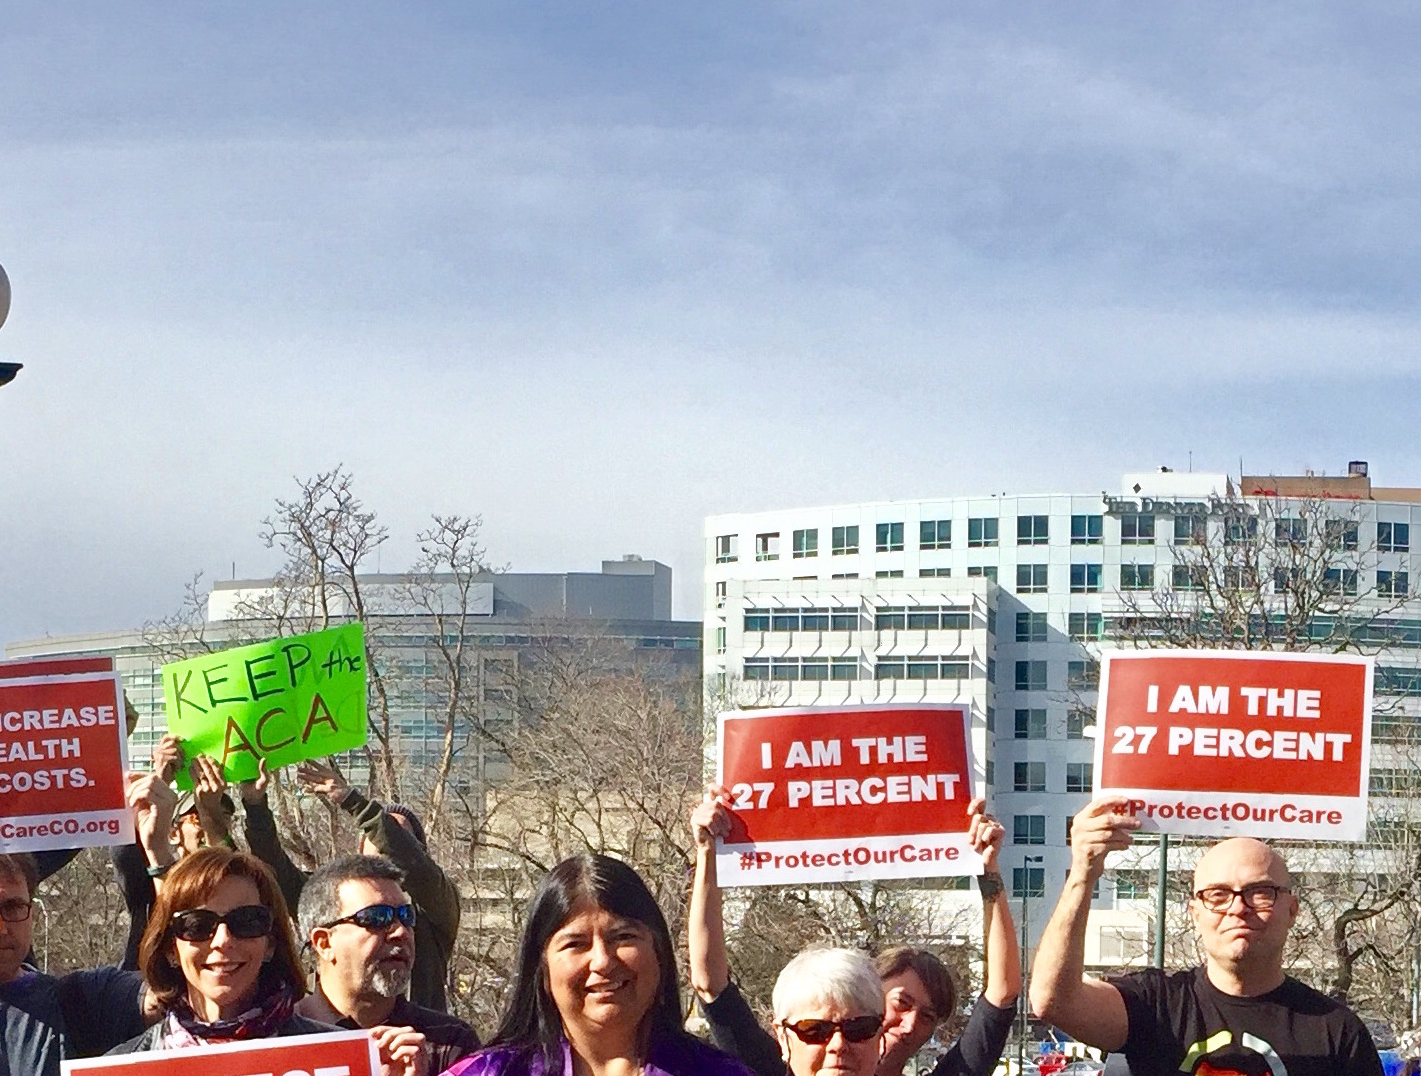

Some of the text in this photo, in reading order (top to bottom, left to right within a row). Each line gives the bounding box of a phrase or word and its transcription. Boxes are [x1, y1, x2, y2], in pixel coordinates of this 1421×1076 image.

[172, 643, 362, 719] KEEP the
[1147, 684, 1321, 719] I AM THE
[221, 692, 339, 770] ACA
[1112, 725, 1352, 762] 27 PERCENT
[761, 735, 928, 769] I AM THE
[731, 773, 961, 811] 27 PERCENT
[740, 844, 960, 871] #ProtectOurCare
